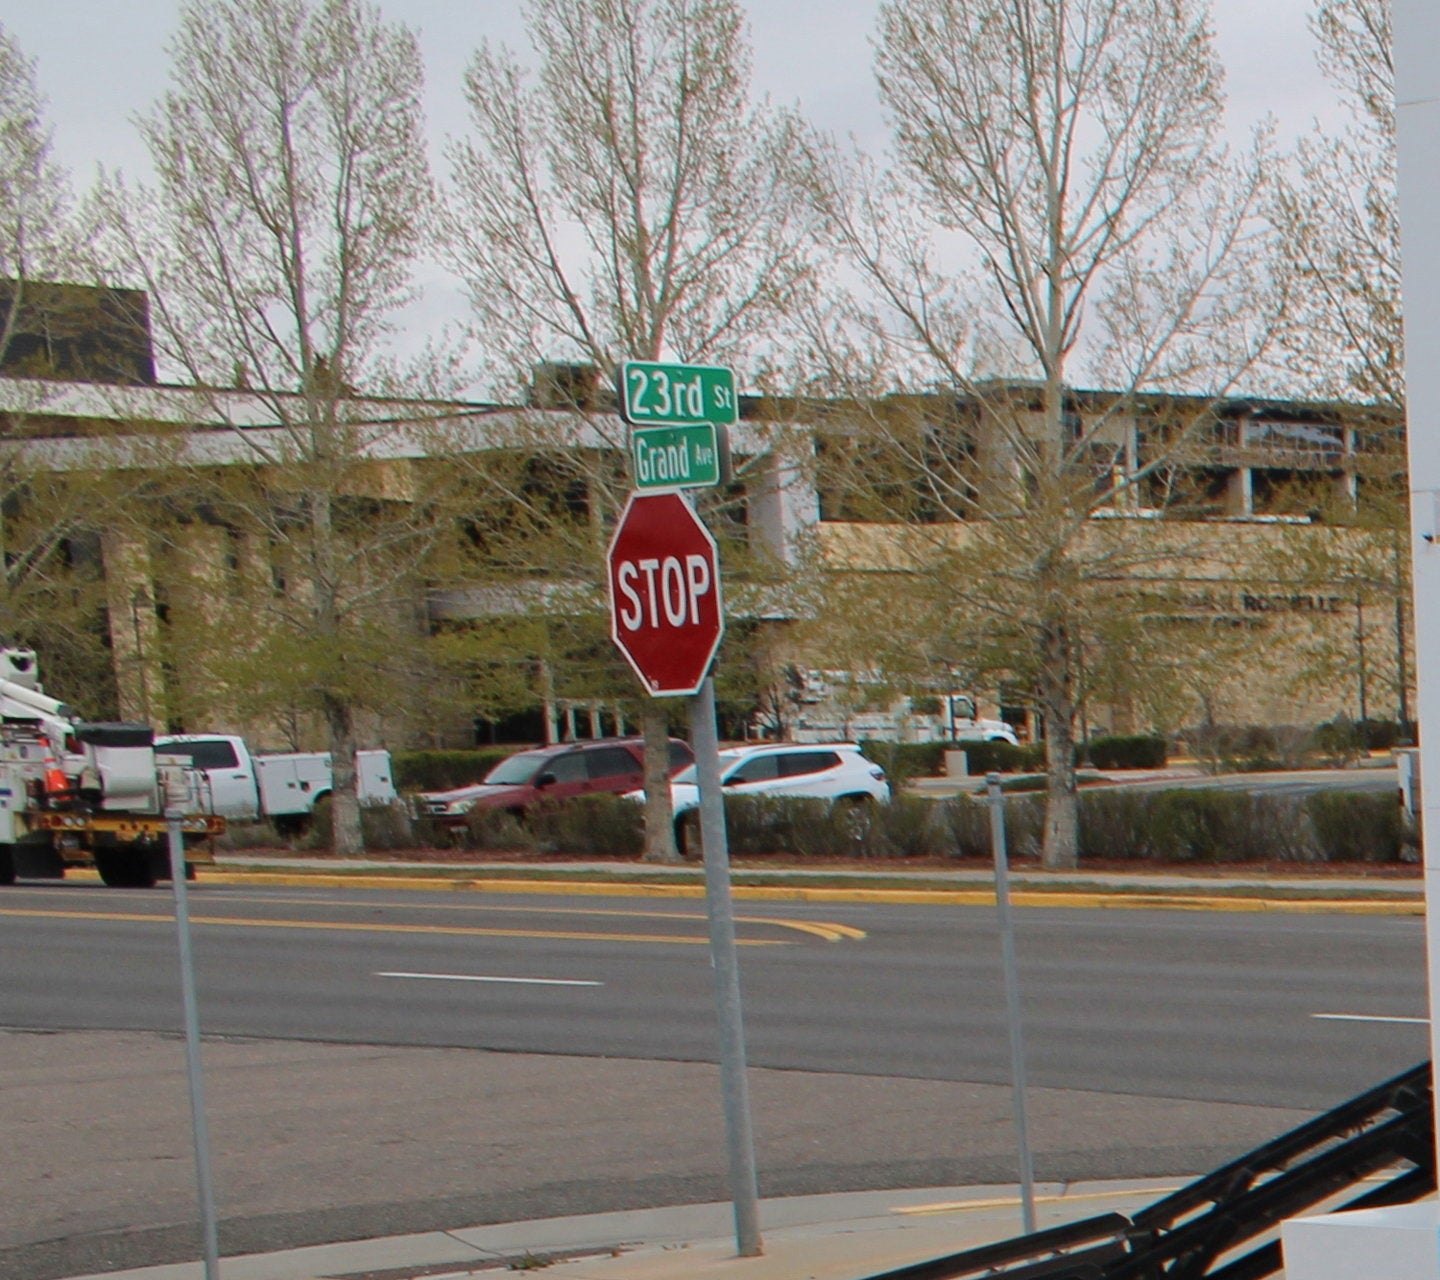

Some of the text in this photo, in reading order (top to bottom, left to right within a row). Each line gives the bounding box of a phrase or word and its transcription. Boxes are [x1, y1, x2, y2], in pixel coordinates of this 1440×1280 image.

[628, 369, 733, 418] 23rd St
[635, 436, 714, 483] Grand Ave
[617, 553, 711, 633] STOP
